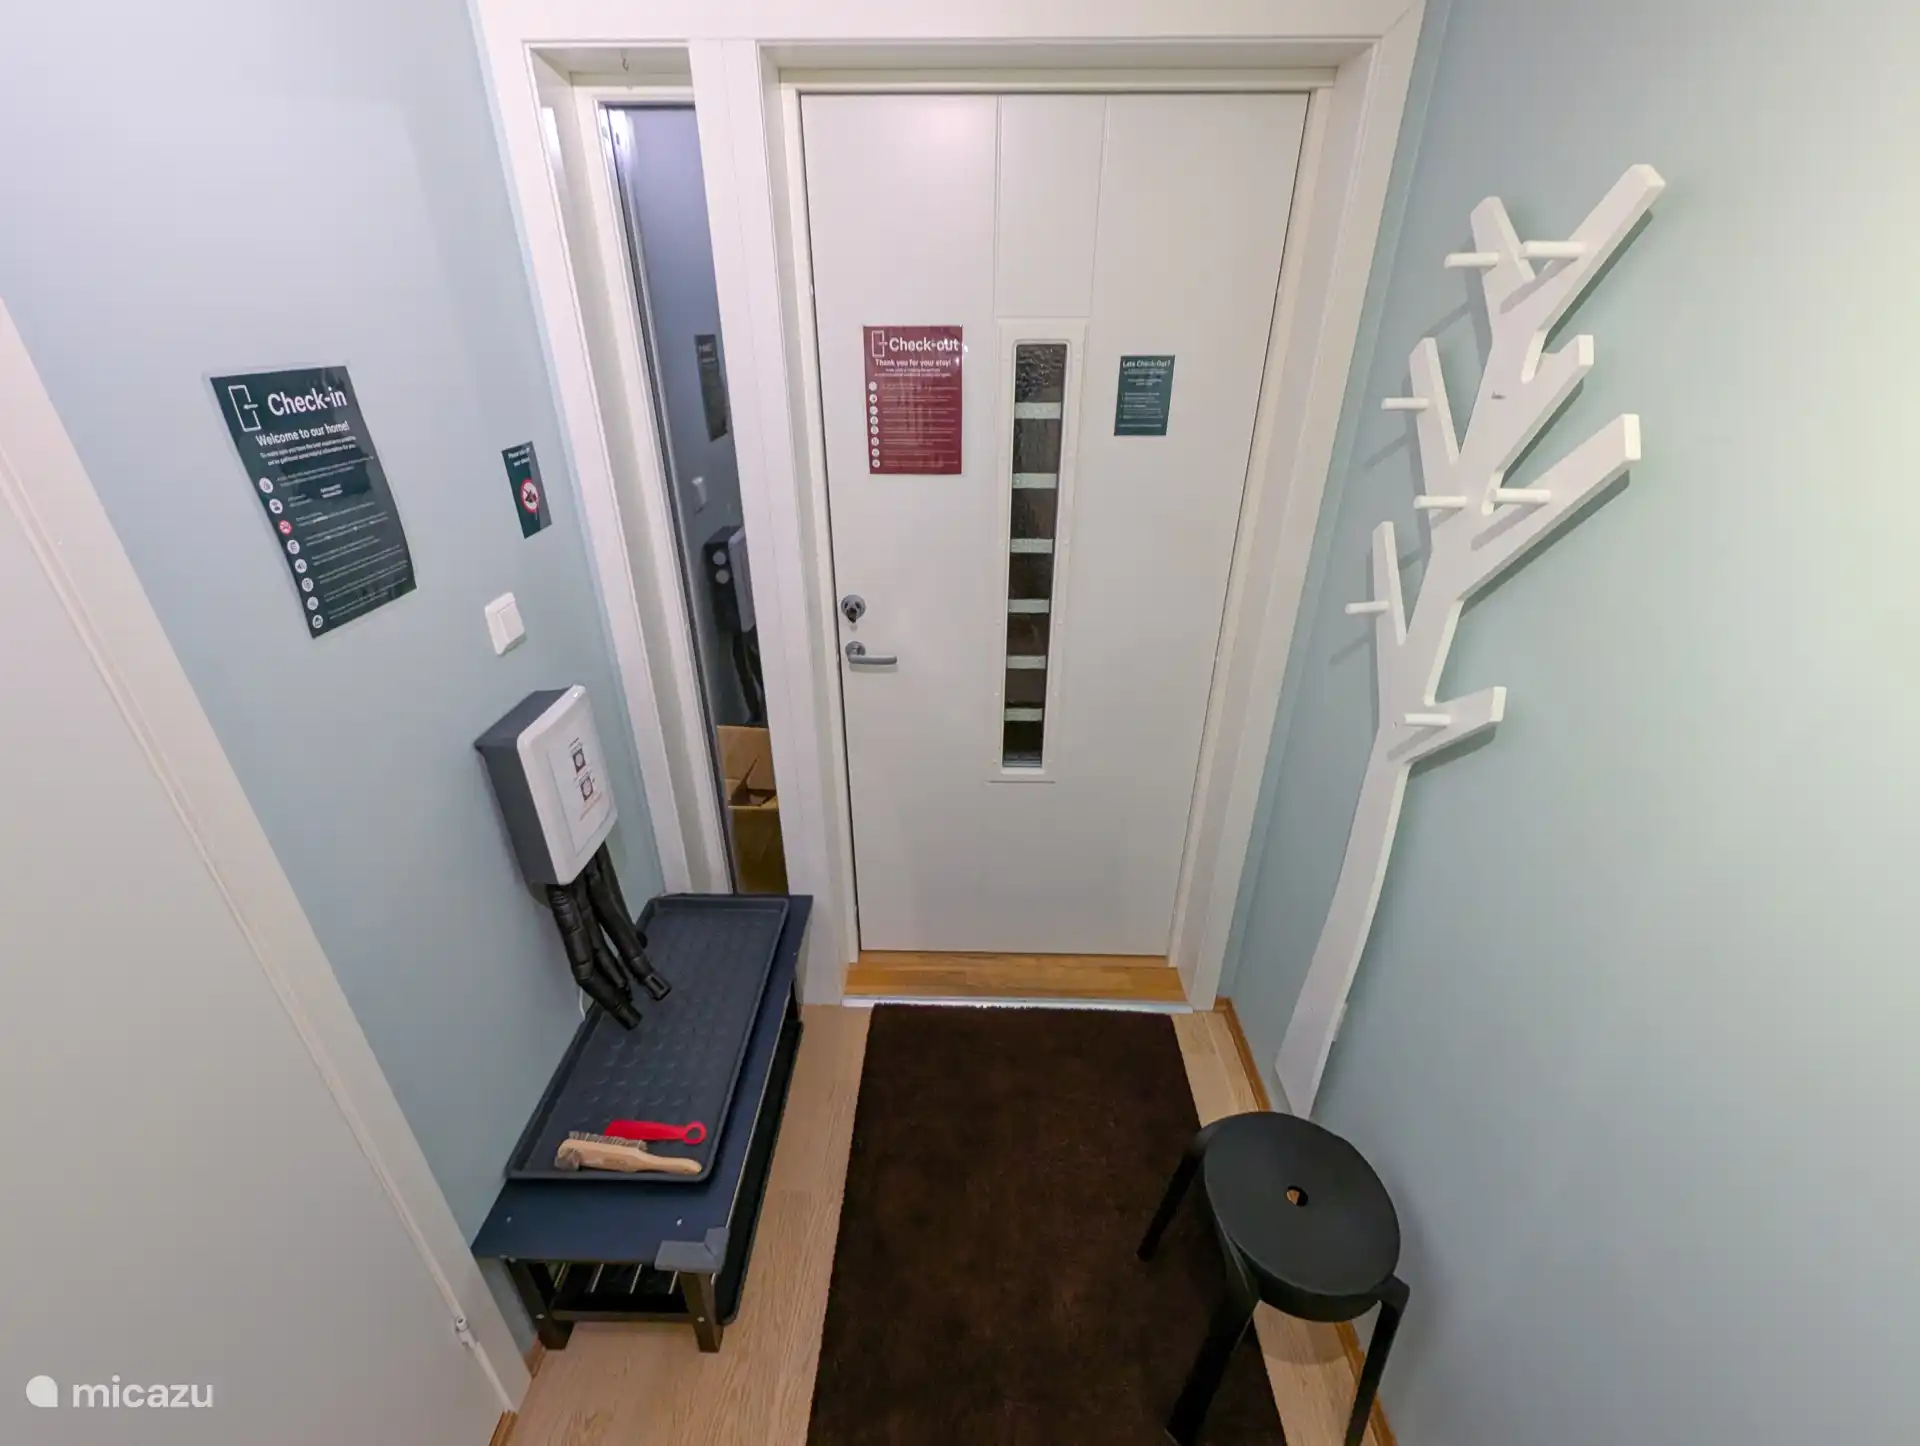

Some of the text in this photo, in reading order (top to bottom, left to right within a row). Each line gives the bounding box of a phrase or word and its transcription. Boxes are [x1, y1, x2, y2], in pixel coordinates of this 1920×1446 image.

[889, 337, 959, 351] Check-out
[935, 359, 951, 368] stay!
[267, 386, 348, 416] Check-in
[255, 420, 350, 446] Welcome to our home!
